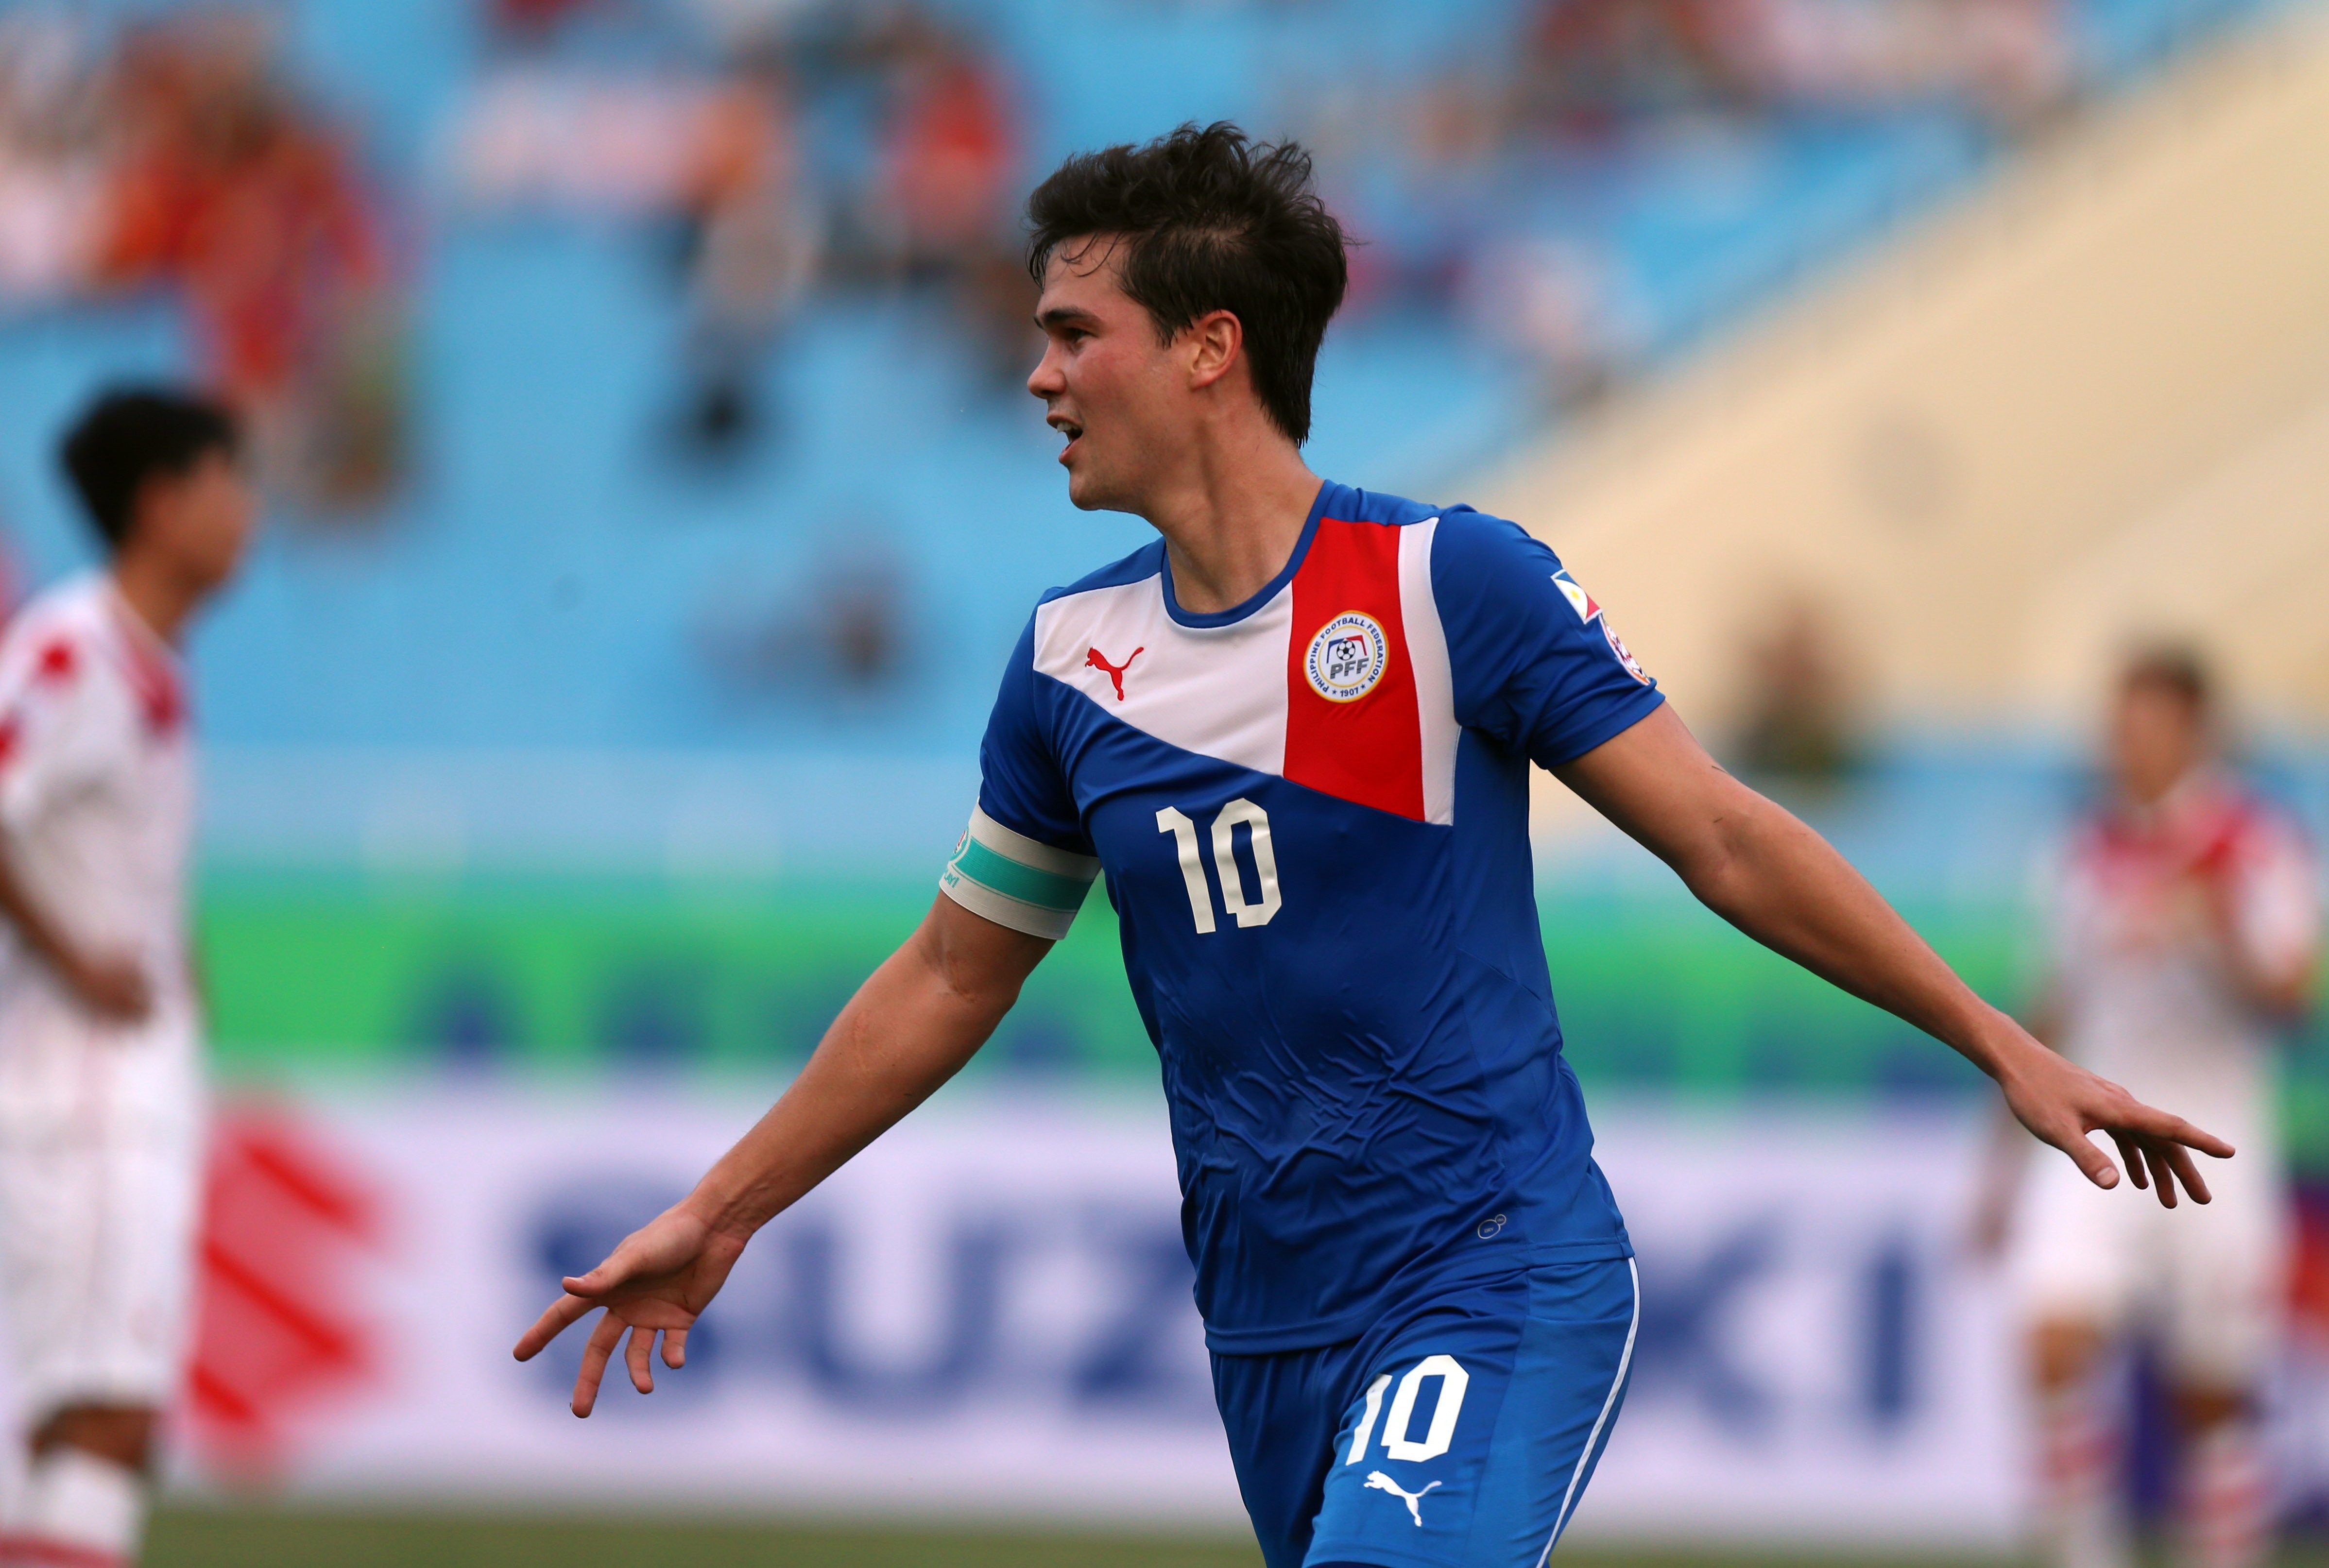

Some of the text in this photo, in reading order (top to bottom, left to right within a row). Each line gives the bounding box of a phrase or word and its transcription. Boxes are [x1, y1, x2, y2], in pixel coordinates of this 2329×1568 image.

[1310, 617, 1383, 693] PHILIPPINE FOOTBALL FEDERATION
[1330, 657, 1370, 680] PFF
[1340, 686, 1359, 697] 1907
[1155, 797, 1282, 934] 10
[525, 1185, 1924, 1428] SUZKI
[1345, 1354, 1470, 1466] 10
